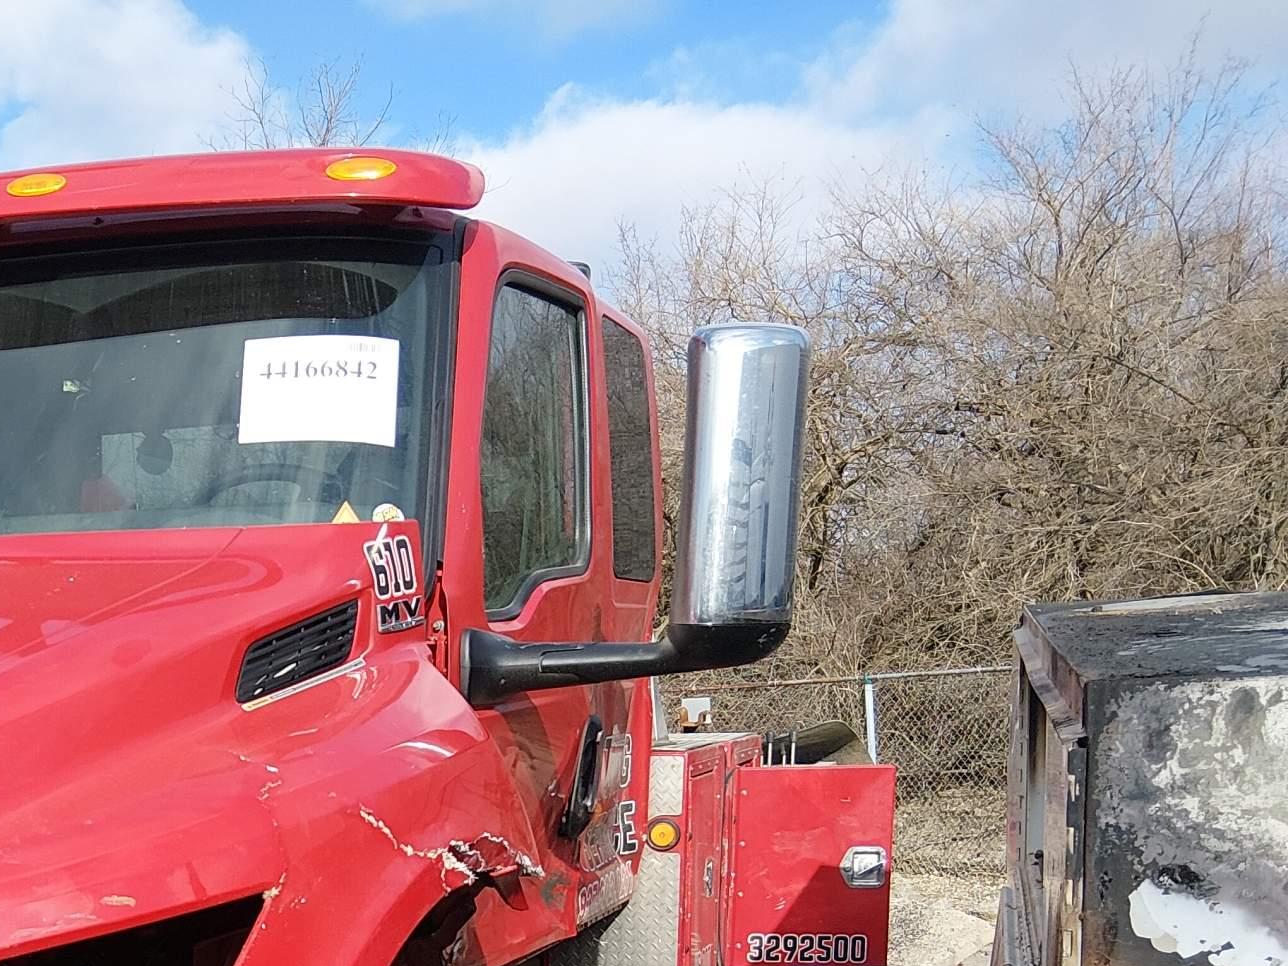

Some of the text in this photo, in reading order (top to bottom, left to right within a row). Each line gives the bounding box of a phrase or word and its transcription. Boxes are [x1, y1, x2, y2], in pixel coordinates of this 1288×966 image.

[259, 359, 378, 380] 44166842
[363, 535, 418, 600] 610
[376, 596, 423, 626] MV
[747, 933, 868, 963] 3292500
